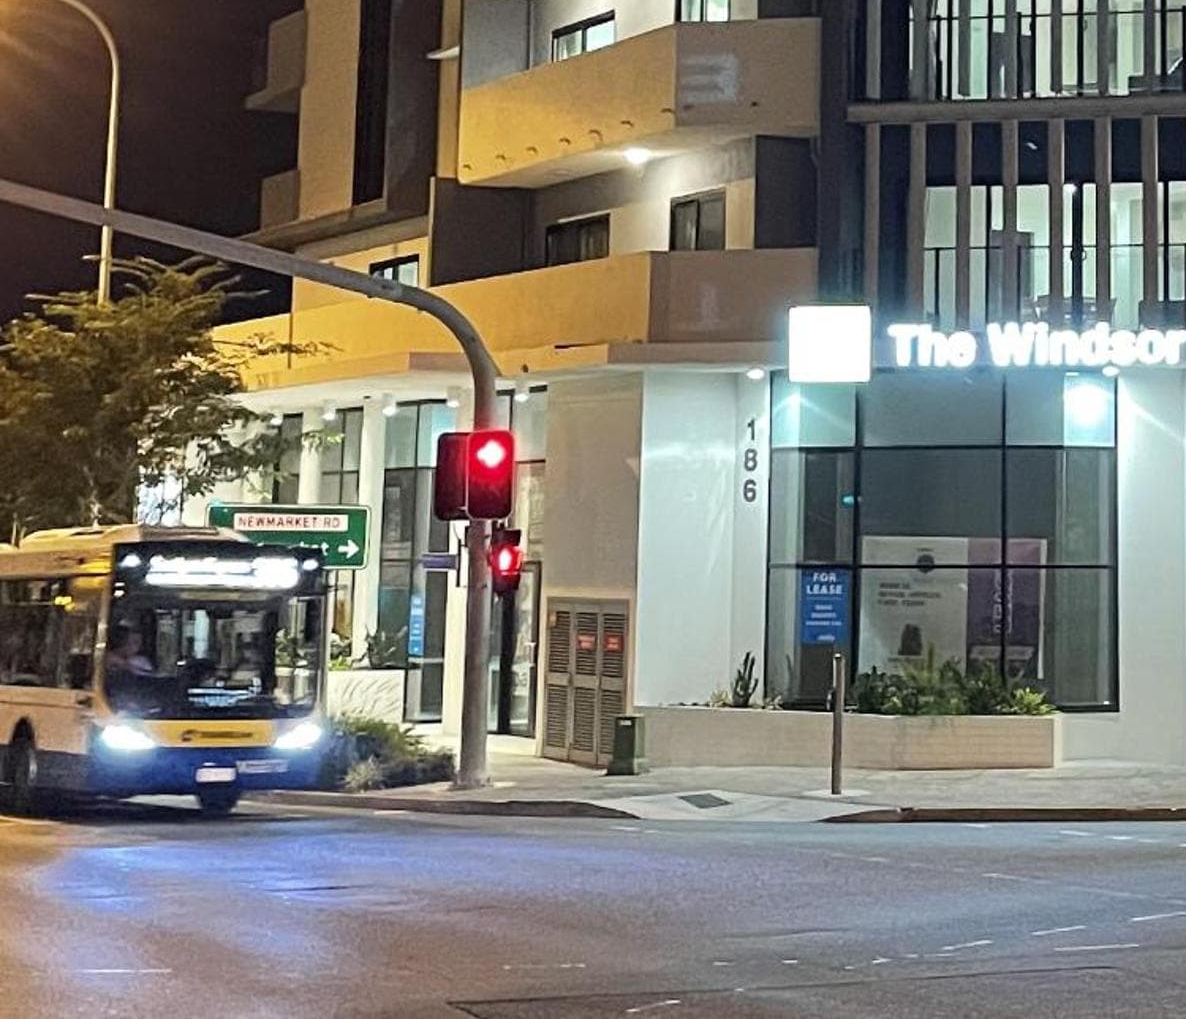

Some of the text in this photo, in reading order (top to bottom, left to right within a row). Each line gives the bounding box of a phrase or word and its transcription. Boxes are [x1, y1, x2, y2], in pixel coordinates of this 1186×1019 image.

[887, 323, 977, 366] The
[743, 418, 758, 503] 186
[238, 516, 341, 528] NEWMARKET RD
[812, 572, 837, 583] FOR
[806, 584, 843, 594] LEASE
